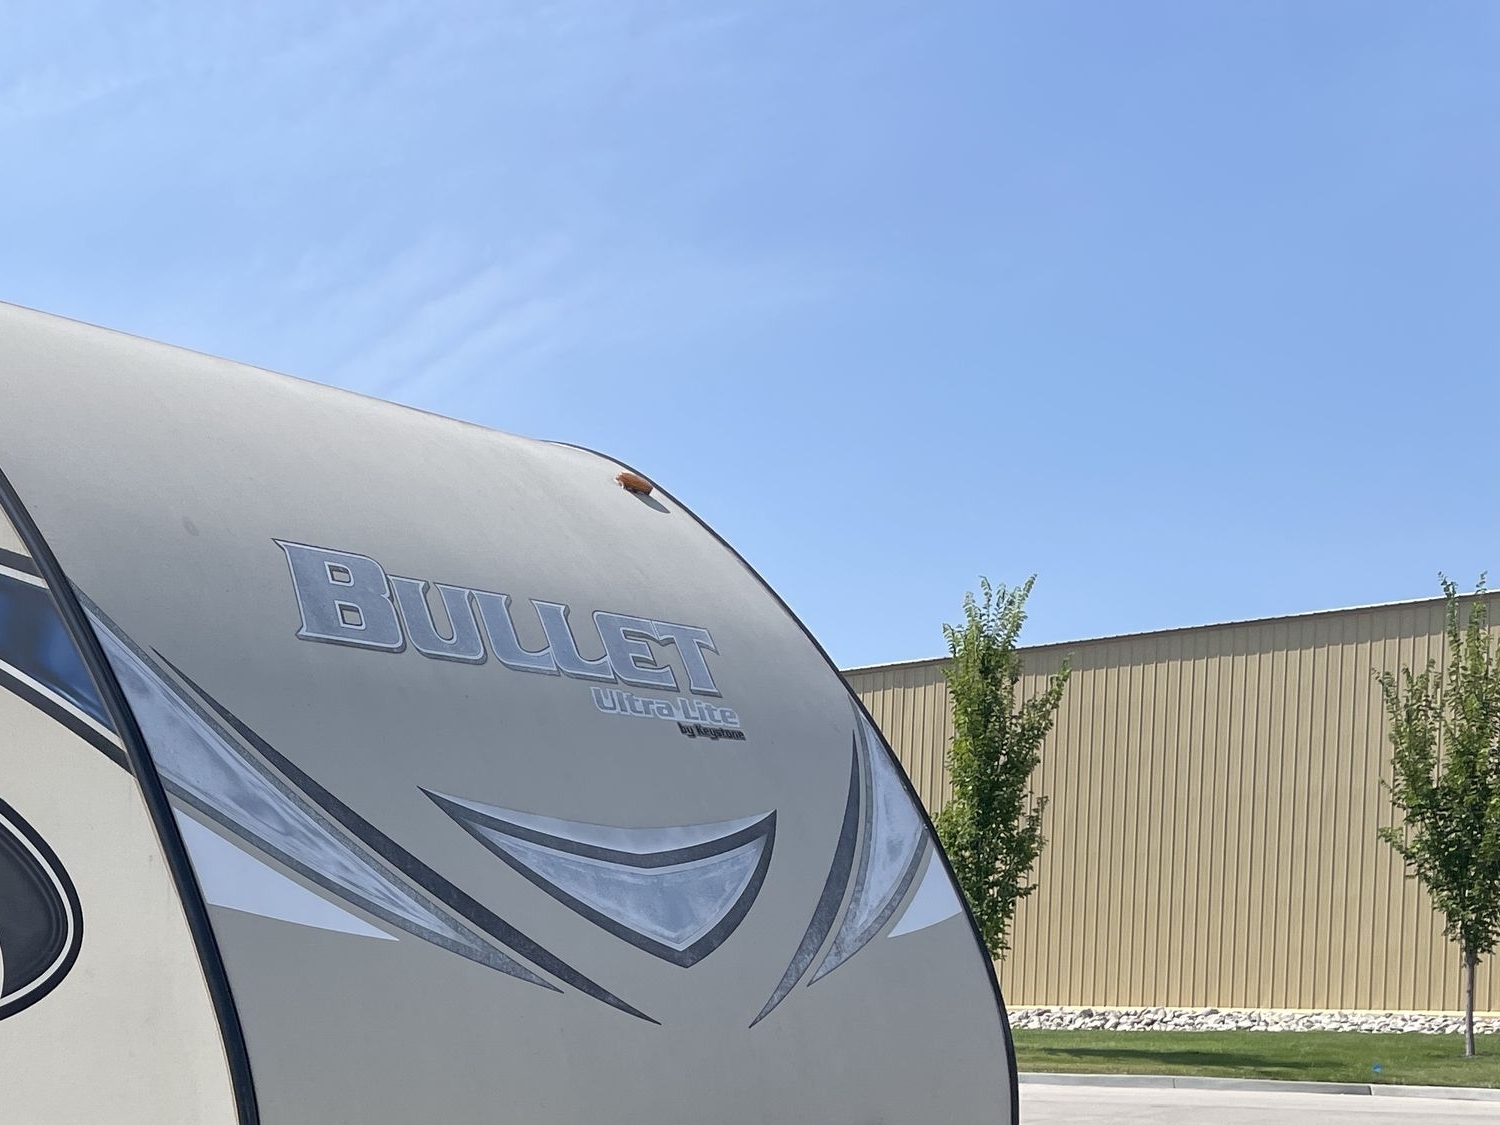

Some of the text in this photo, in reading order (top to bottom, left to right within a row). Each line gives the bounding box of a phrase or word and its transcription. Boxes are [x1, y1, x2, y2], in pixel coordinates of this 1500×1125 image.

[273, 538, 722, 698] BULLET
[591, 687, 740, 728] Ultra Lite
[678, 723, 746, 741] by Keystone
